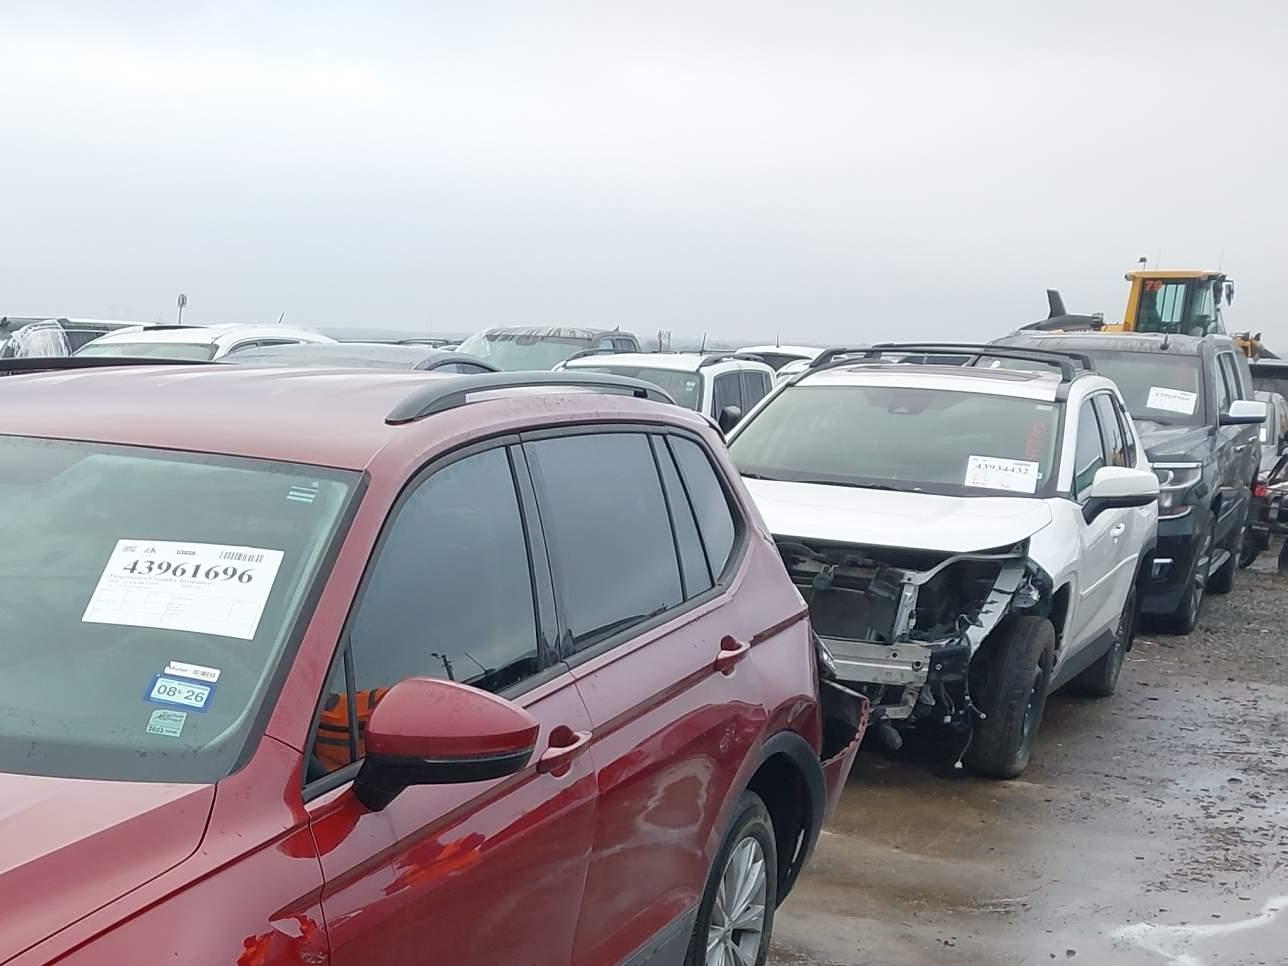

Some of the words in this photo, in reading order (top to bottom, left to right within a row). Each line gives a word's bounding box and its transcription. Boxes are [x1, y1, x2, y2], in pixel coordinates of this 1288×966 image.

[122, 559, 257, 584] 43961696
[157, 684, 177, 697] 08
[183, 689, 206, 703] 26
